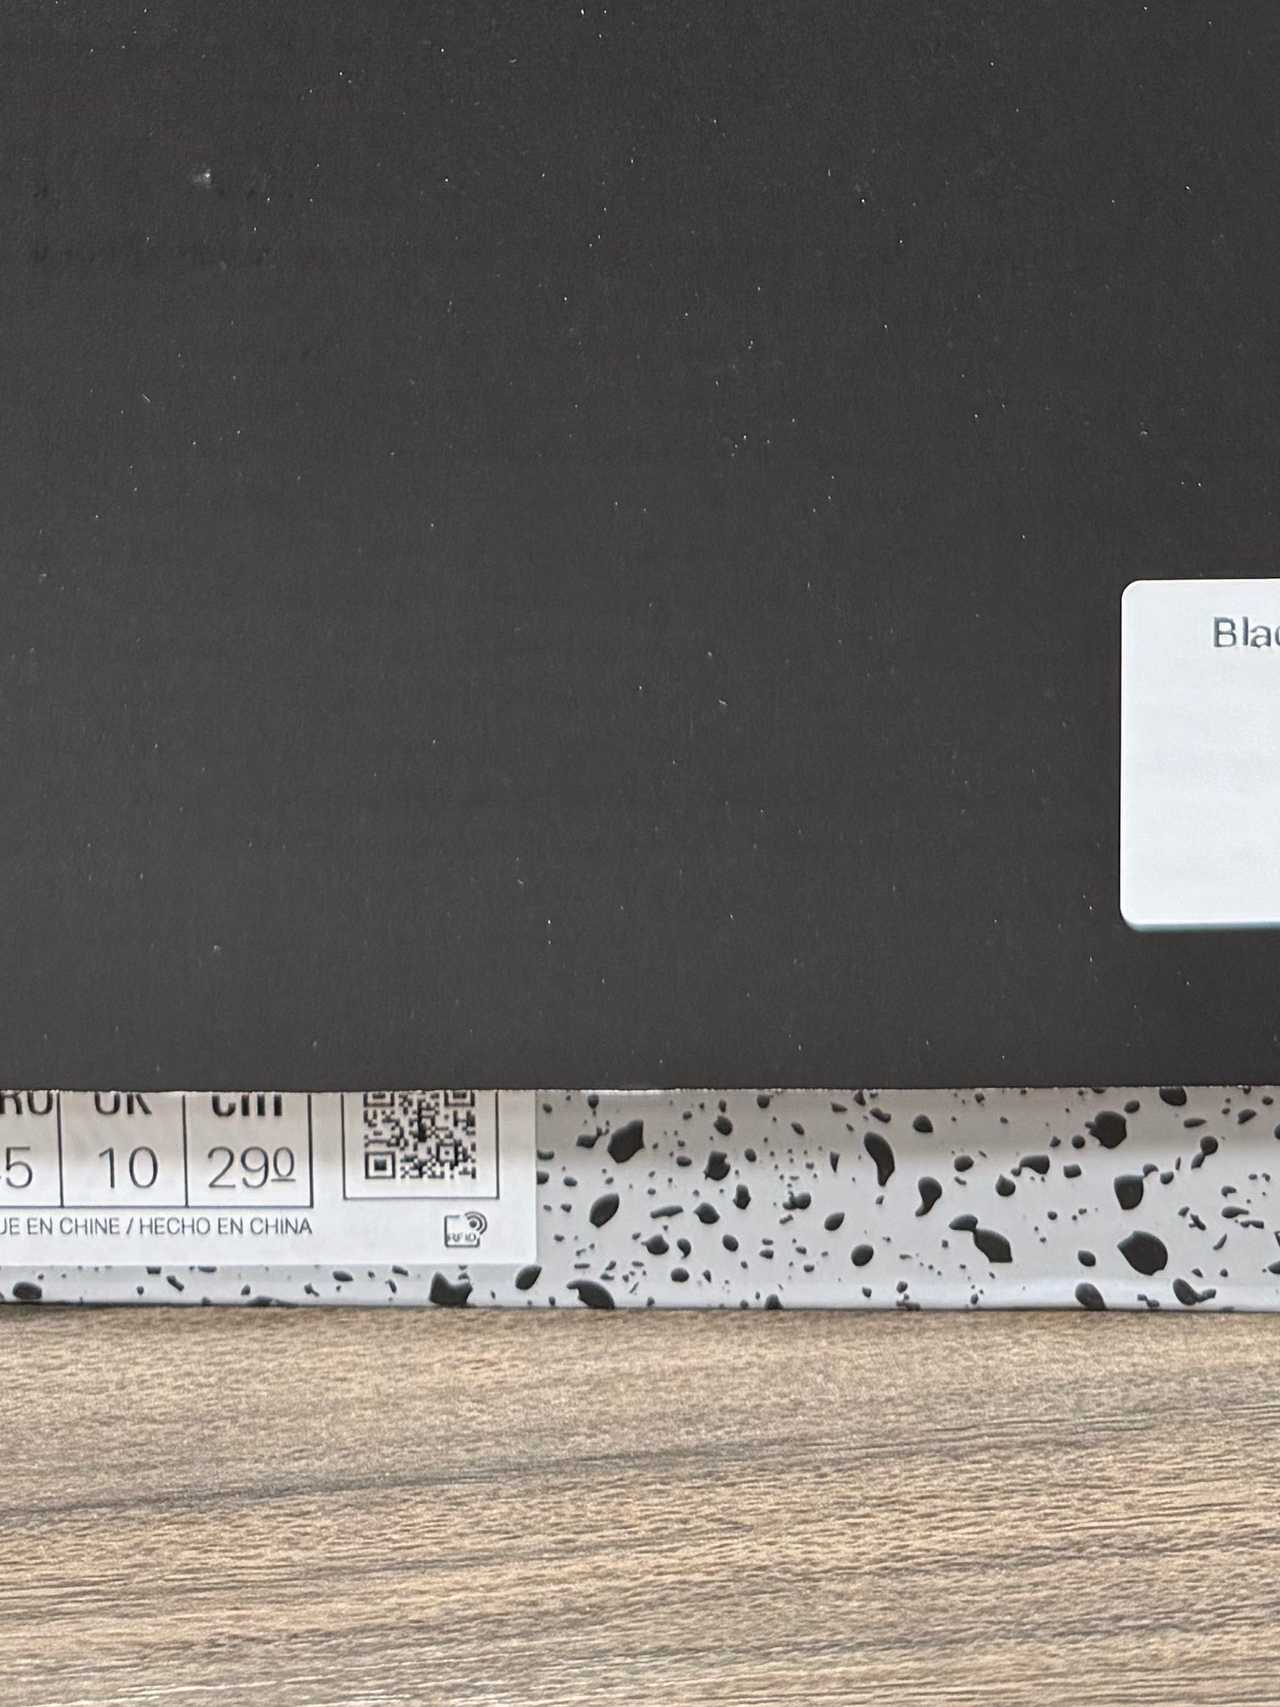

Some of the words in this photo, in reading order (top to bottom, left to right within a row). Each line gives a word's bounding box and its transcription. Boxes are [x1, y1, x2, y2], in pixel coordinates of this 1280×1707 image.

[98, 1146, 158, 1189] 10
[26, 1217, 53, 1236] EN
[59, 1217, 121, 1236] CHINE
[139, 1217, 211, 1236] HECHO
[217, 1217, 244, 1235] EN
[249, 1217, 313, 1236] CHINA
